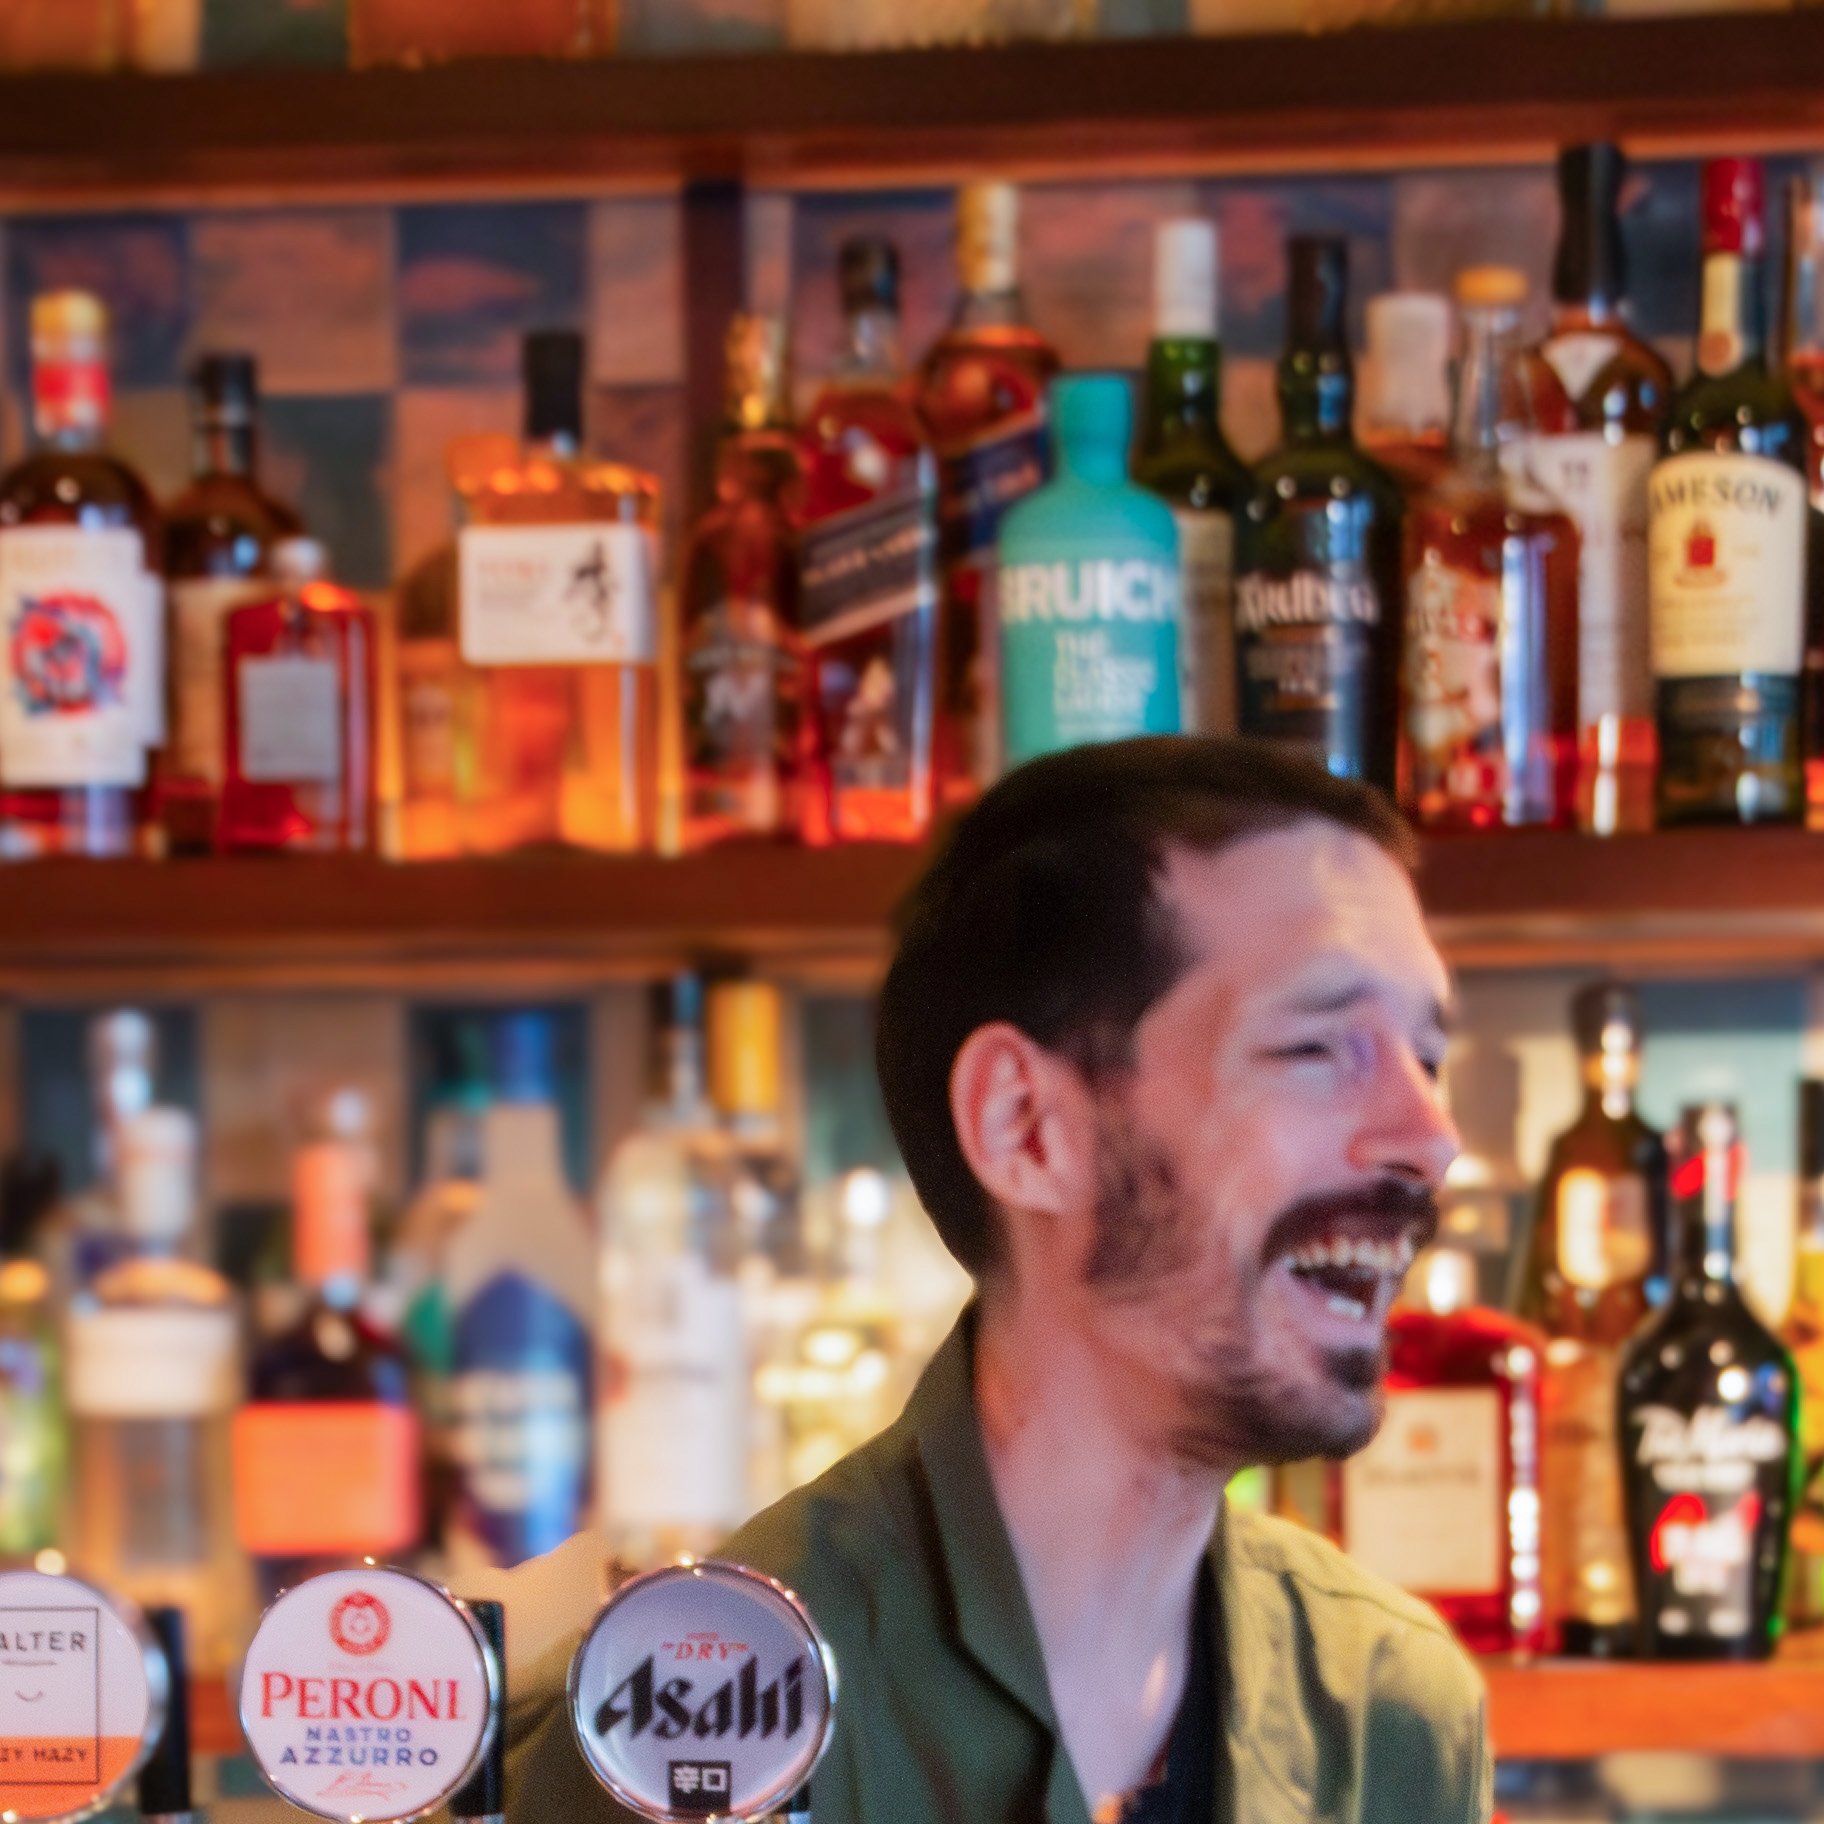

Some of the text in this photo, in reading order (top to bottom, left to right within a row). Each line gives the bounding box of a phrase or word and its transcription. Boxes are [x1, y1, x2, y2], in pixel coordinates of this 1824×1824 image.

[260, 1670, 468, 1721] PERONI
[593, 1653, 805, 1739] Asahi
[306, 1727, 411, 1743] NASTRO
[279, 1747, 439, 1767] AZZURRO
